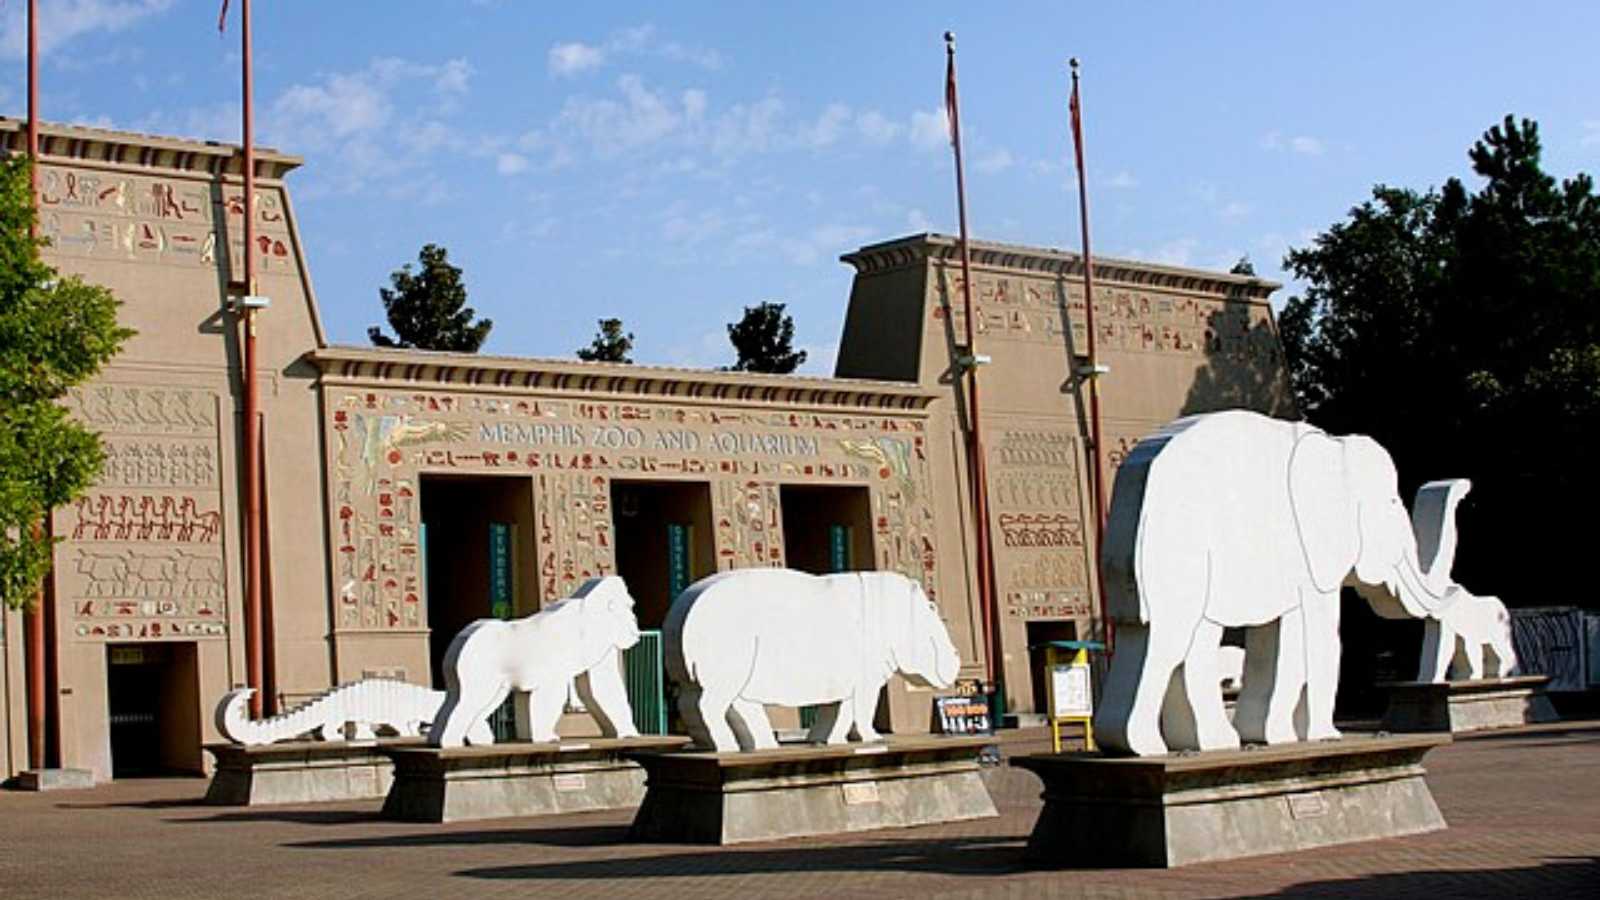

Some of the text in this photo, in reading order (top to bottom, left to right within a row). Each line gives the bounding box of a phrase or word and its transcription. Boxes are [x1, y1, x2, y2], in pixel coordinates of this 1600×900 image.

[479, 422, 819, 457] MEMPHIS ZOO AND AQUARIUM
